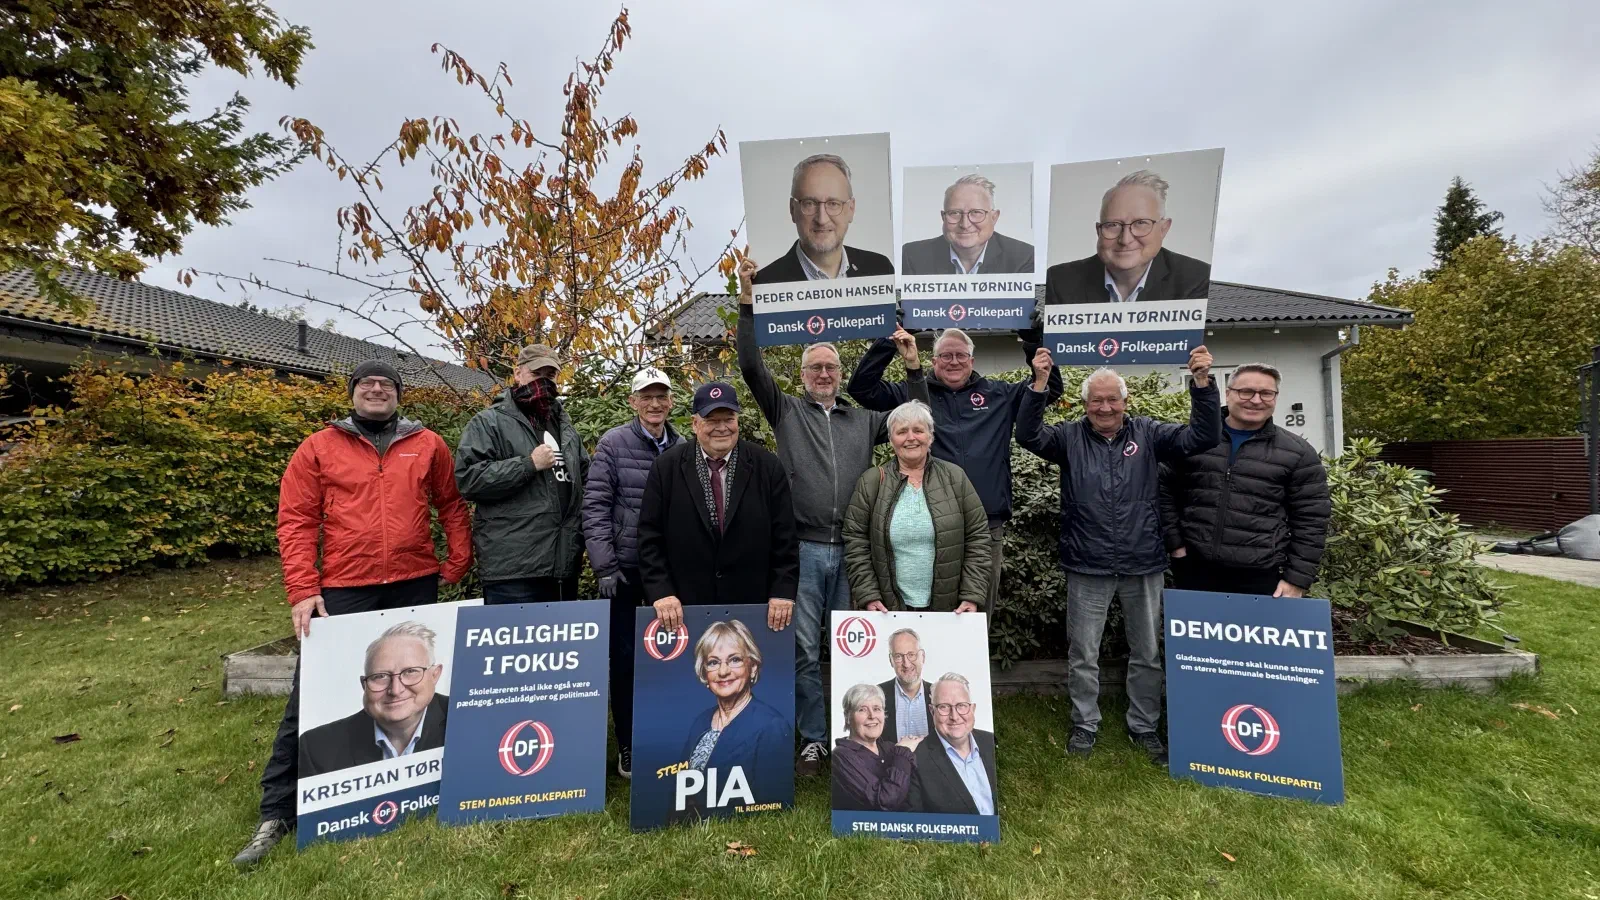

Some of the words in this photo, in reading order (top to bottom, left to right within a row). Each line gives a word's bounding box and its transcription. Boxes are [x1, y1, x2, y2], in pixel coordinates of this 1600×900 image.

[755, 291, 794, 304] PEDER
[797, 288, 842, 301] CABION
[846, 284, 894, 297] HANSEN
[904, 282, 967, 293] KRISTIAN
[971, 281, 1032, 292] TØRNING
[912, 307, 946, 318] Dansk
[967, 307, 1023, 319] Folkeparti
[1047, 312, 1123, 326] KRISTIAN
[1127, 309, 1203, 323] TØRNING
[768, 321, 805, 334] Dansk
[827, 314, 885, 329] Folkeparti
[1056, 342, 1096, 353] Dansk
[1121, 339, 1188, 354] Folkeparti
[646, 368, 659, 379] NY
[1285, 414, 1306, 427] 28
[466, 622, 599, 647] FAGLIGHED
[656, 631, 676, 645] DF
[847, 631, 865, 643] DF
[1170, 618, 1328, 650] DEMOKRATI
[483, 656, 494, 675] I
[500, 651, 579, 674] FOKUS
[1175, 653, 1245, 667] Gladsaxeborgerne
[1246, 660, 1262, 669] skal
[1264, 662, 1289, 672] kunne
[1290, 665, 1325, 675] stemme
[1194, 664, 1217, 673] større
[1218, 668, 1264, 678] kommunale
[1265, 672, 1320, 685] beslutninger.
[469, 686, 519, 696] Skolelæreren
[520, 684, 536, 692] skal
[537, 682, 553, 691] ikke
[554, 681, 571, 691] også
[456, 698, 494, 708] pædagog,
[495, 693, 548, 705] socialrådgiver
[549, 693, 558, 701] og
[559, 690, 600, 701] politimand.
[1238, 721, 1263, 738] DF
[514, 739, 539, 757] DF
[656, 760, 689, 779] STEM
[1189, 762, 1215, 774] STEM
[1218, 766, 1252, 780] DANSK
[1254, 772, 1322, 790] FOLKEPARTI!
[302, 768, 399, 804] KRISTIAN
[404, 757, 443, 779] TØR
[675, 765, 756, 811] PIA
[459, 799, 486, 811] STEM
[488, 795, 522, 808] DANSK
[525, 788, 586, 804] FOLKEPARTI!
[745, 803, 782, 812] REGIONEN
[317, 811, 370, 836] Dansk
[379, 808, 391, 818] DF
[852, 821, 878, 832] STEM
[880, 822, 914, 833] DANSK
[916, 823, 979, 835] FOLKEPARTI!
